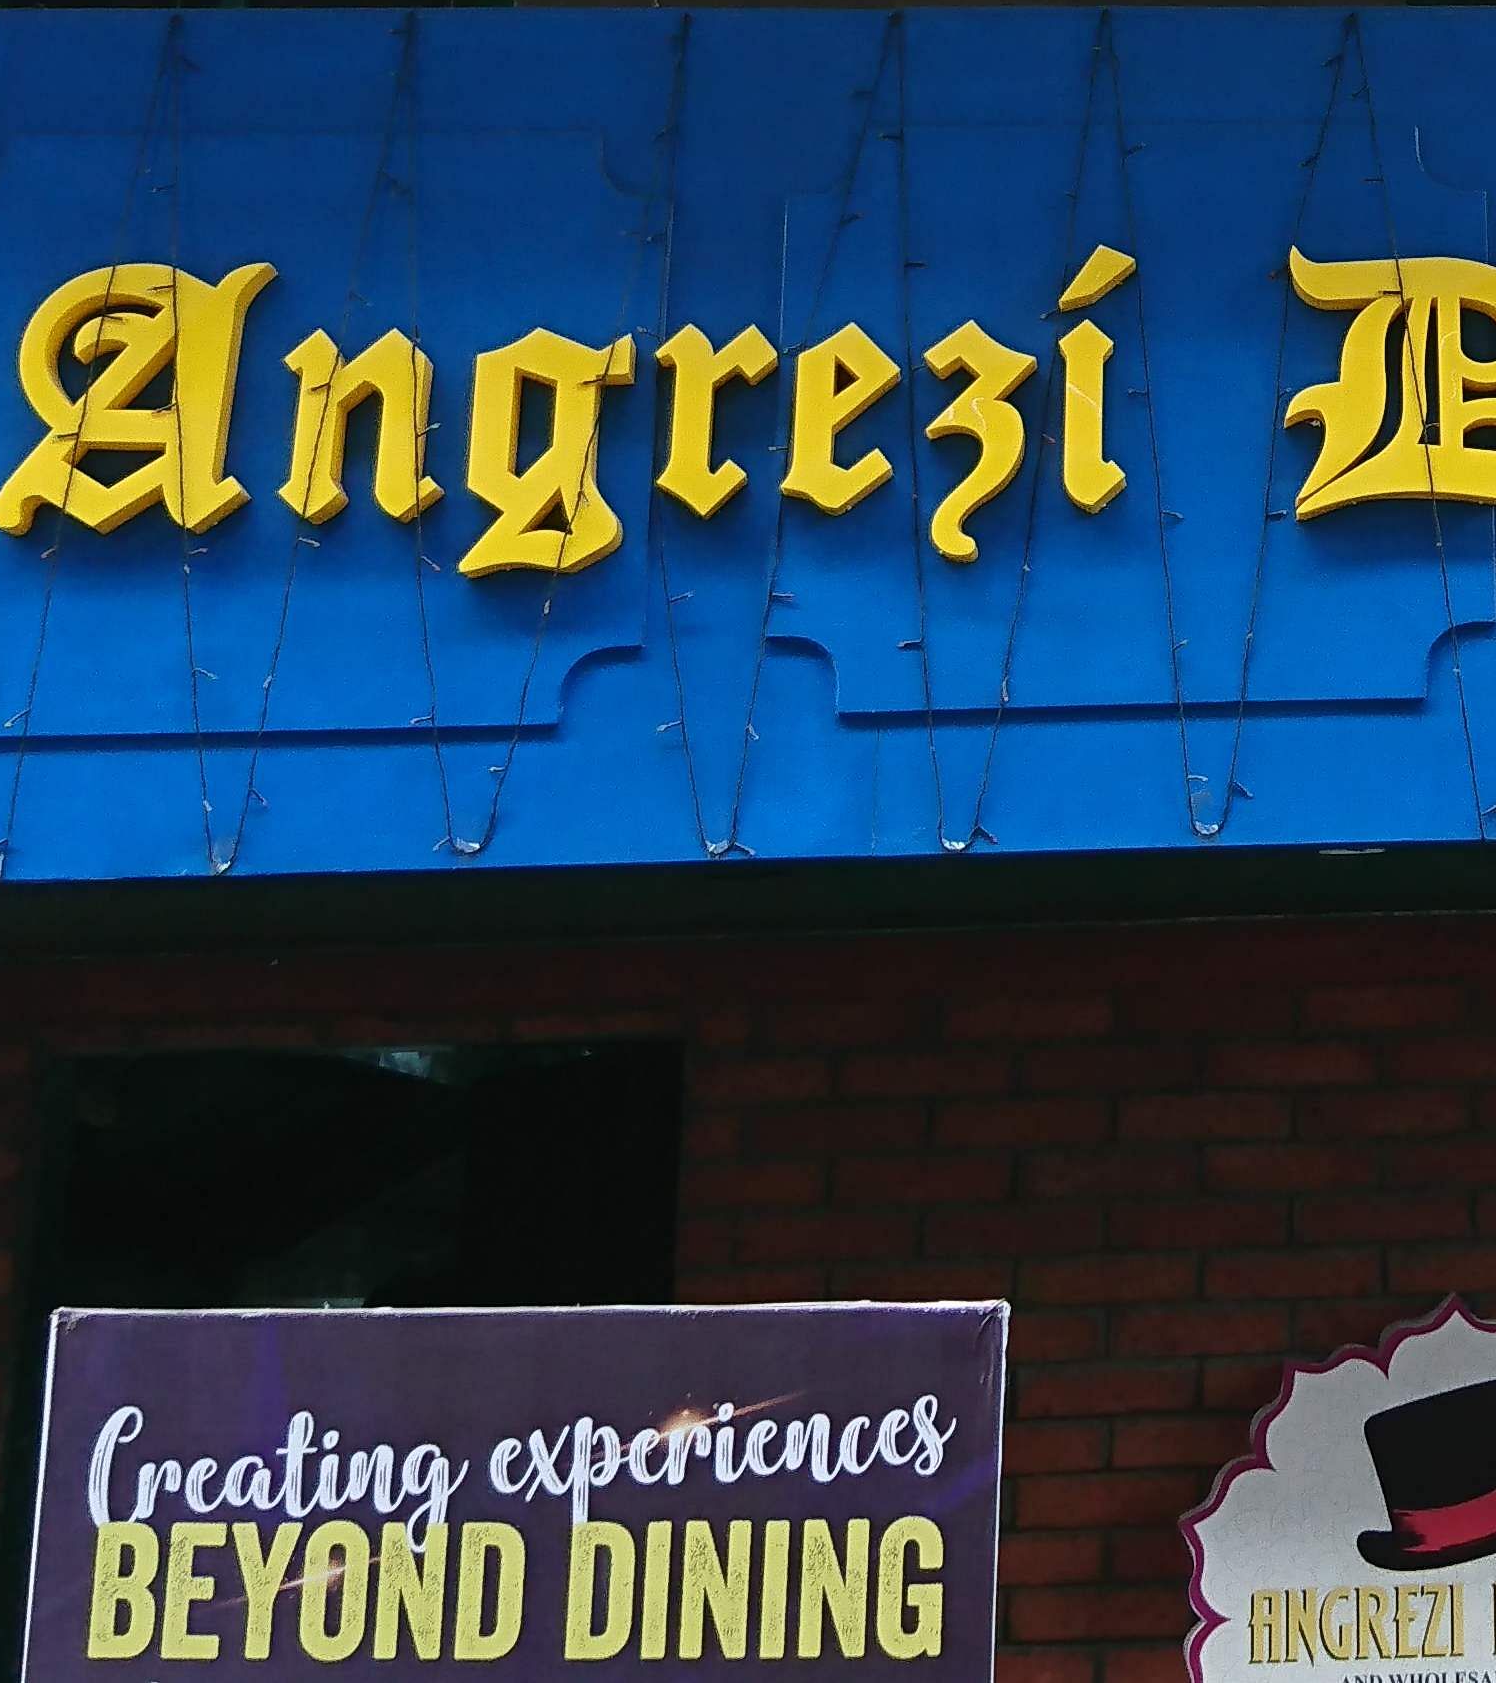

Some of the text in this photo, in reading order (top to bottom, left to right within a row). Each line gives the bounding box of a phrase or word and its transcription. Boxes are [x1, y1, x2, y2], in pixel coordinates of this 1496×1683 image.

[88, 1393, 958, 1554] Creating experiences
[87, 1516, 945, 1661] BEYOND DINING
[1247, 1582, 1465, 1666] ANGREZI
